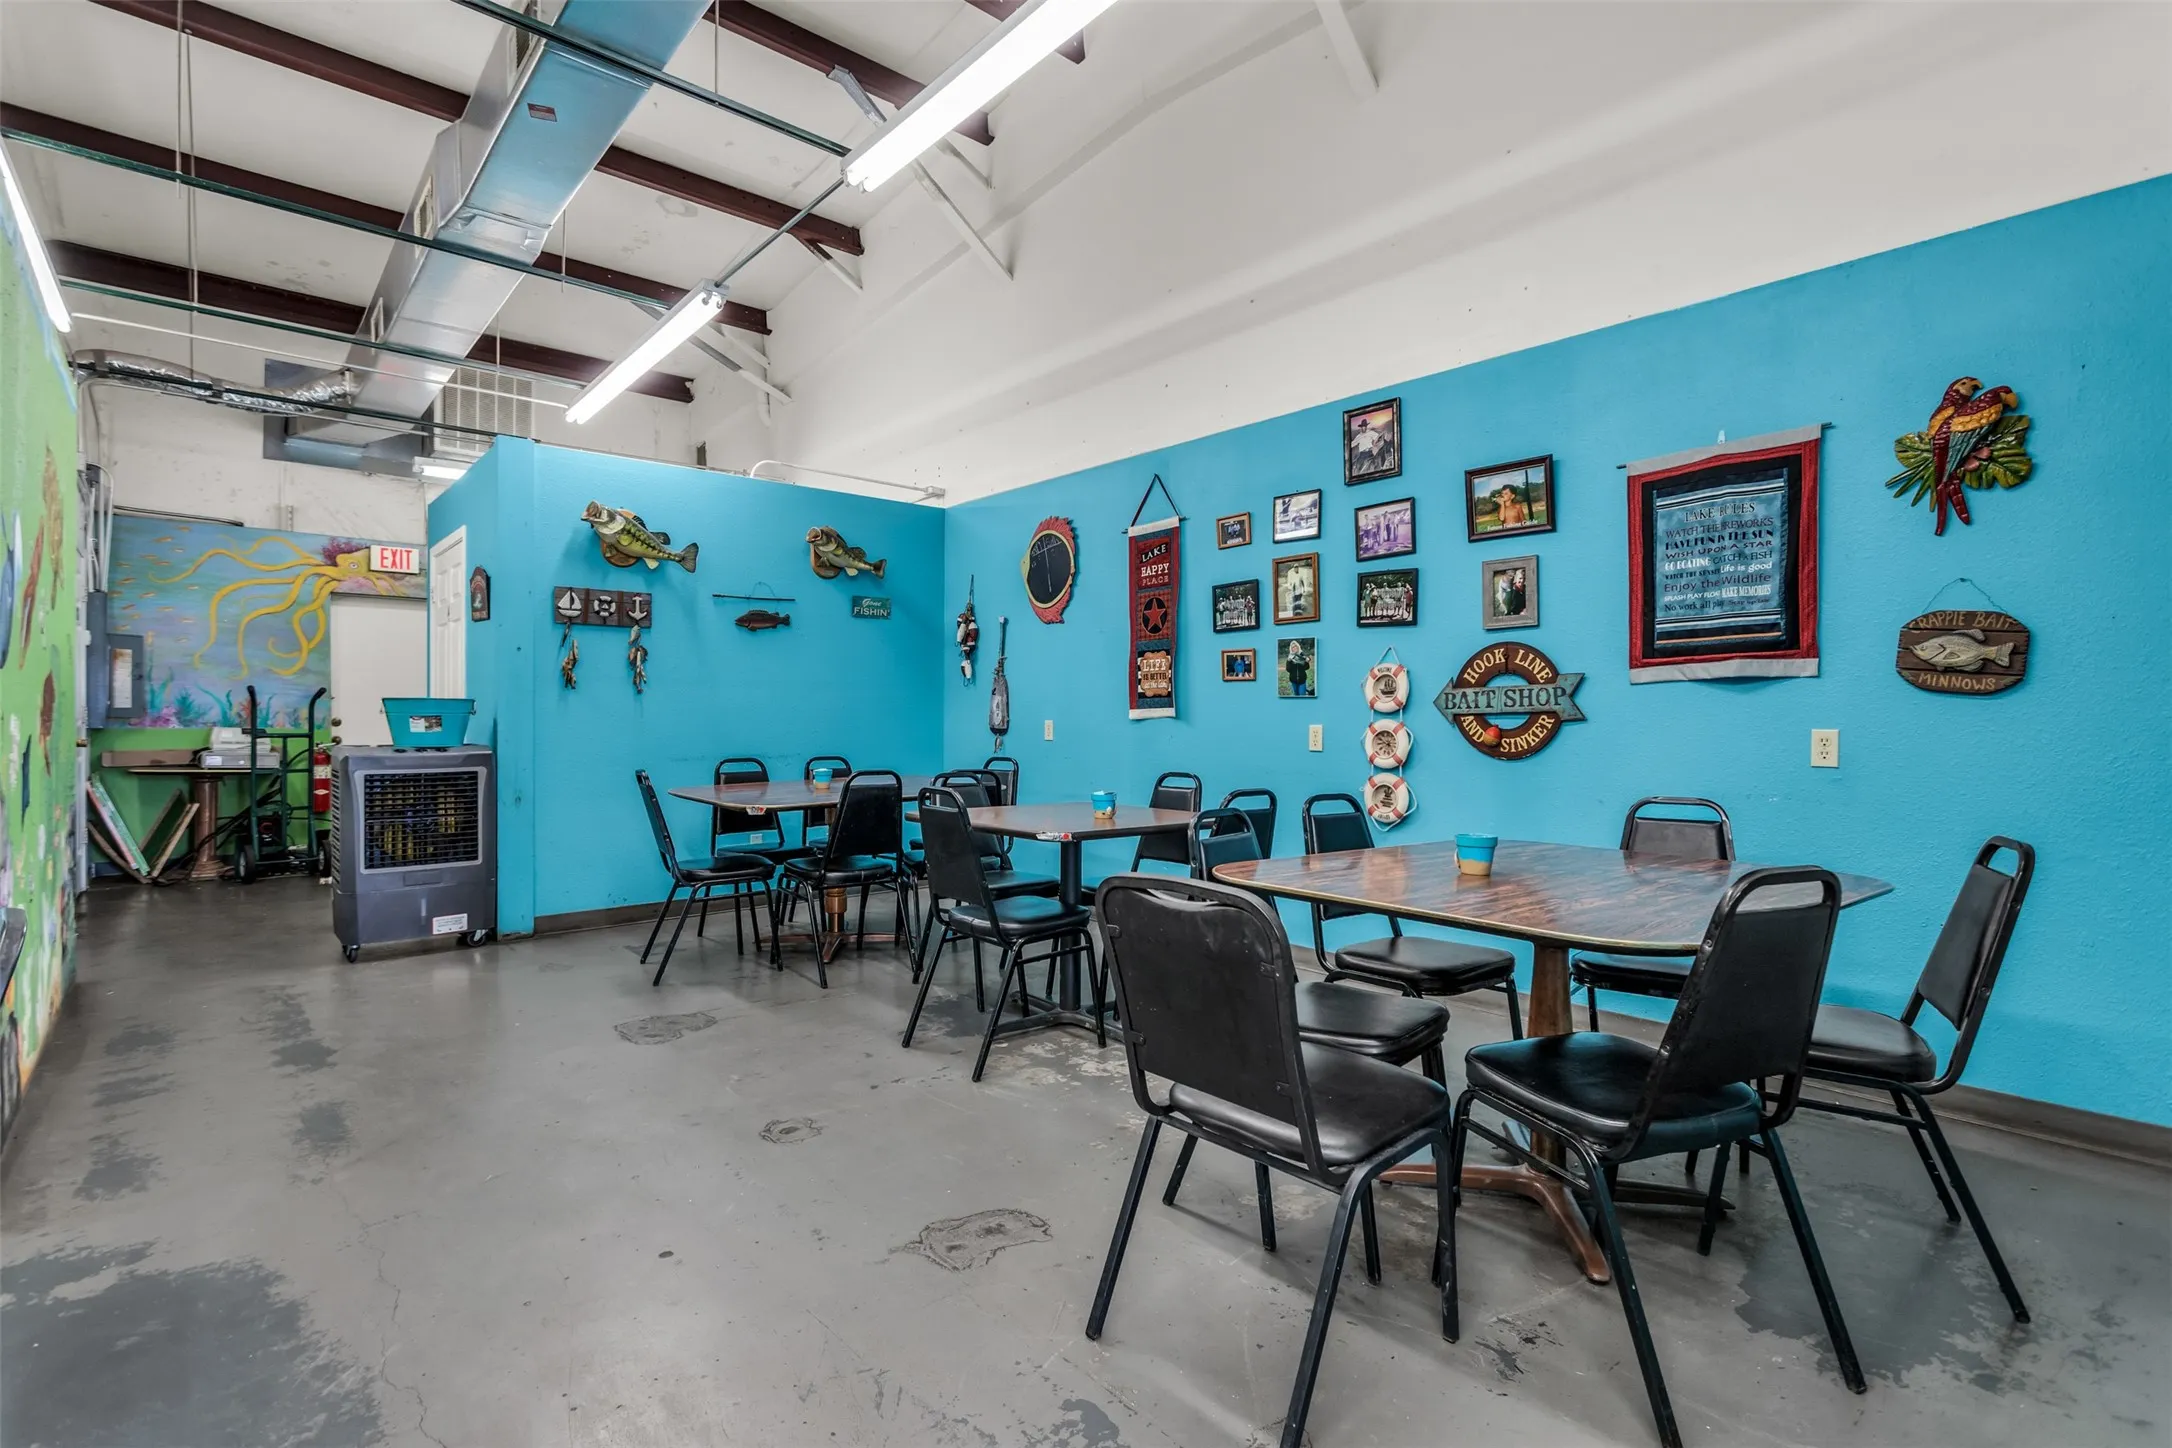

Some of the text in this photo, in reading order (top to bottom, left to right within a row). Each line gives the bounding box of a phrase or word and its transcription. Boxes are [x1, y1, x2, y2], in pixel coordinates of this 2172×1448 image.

[1684, 502, 1755, 522] LAKE RULES
[1665, 539, 1690, 551] HAVE
[1694, 536, 1715, 546] FUN
[1728, 531, 1747, 541] THE
[1751, 529, 1774, 539] SUN
[1666, 526, 1698, 539] WATCH
[1701, 523, 1720, 534] THE
[380, 547, 413, 571] EXIT
[1142, 544, 1167, 562] LAKE
[1665, 550, 1694, 560] WISH
[1698, 545, 1727, 555] UPON
[1743, 540, 1773, 549] STAR
[1141, 563, 1170, 577] HAPPY
[1665, 561, 1676, 571] GO
[1676, 557, 1712, 570] BOATING
[1713, 552, 1741, 565] CATCH
[1750, 550, 1773, 561] FISH
[1721, 564, 1735, 574] Life
[1748, 561, 1773, 573] good
[1142, 575, 1169, 586] PLACE
[1664, 572, 1772, 593] Enjoy the Wildlife
[1664, 594, 1687, 602] SPLASH
[1687, 591, 1703, 600] PLAY
[853, 606, 890, 617] FISHIN'
[1664, 603, 1677, 613] No
[1679, 601, 1698, 611] work
[1700, 600, 1711, 609] all
[1908, 611, 2017, 633] CRAPPIE BAIT
[1142, 658, 1167, 672] LIFE
[1463, 648, 1553, 685] HOOK LINE
[1918, 672, 1996, 691] MINNOWS
[1444, 686, 1568, 710] BAIT SHOP
[1460, 714, 1555, 753] AND SINKER
